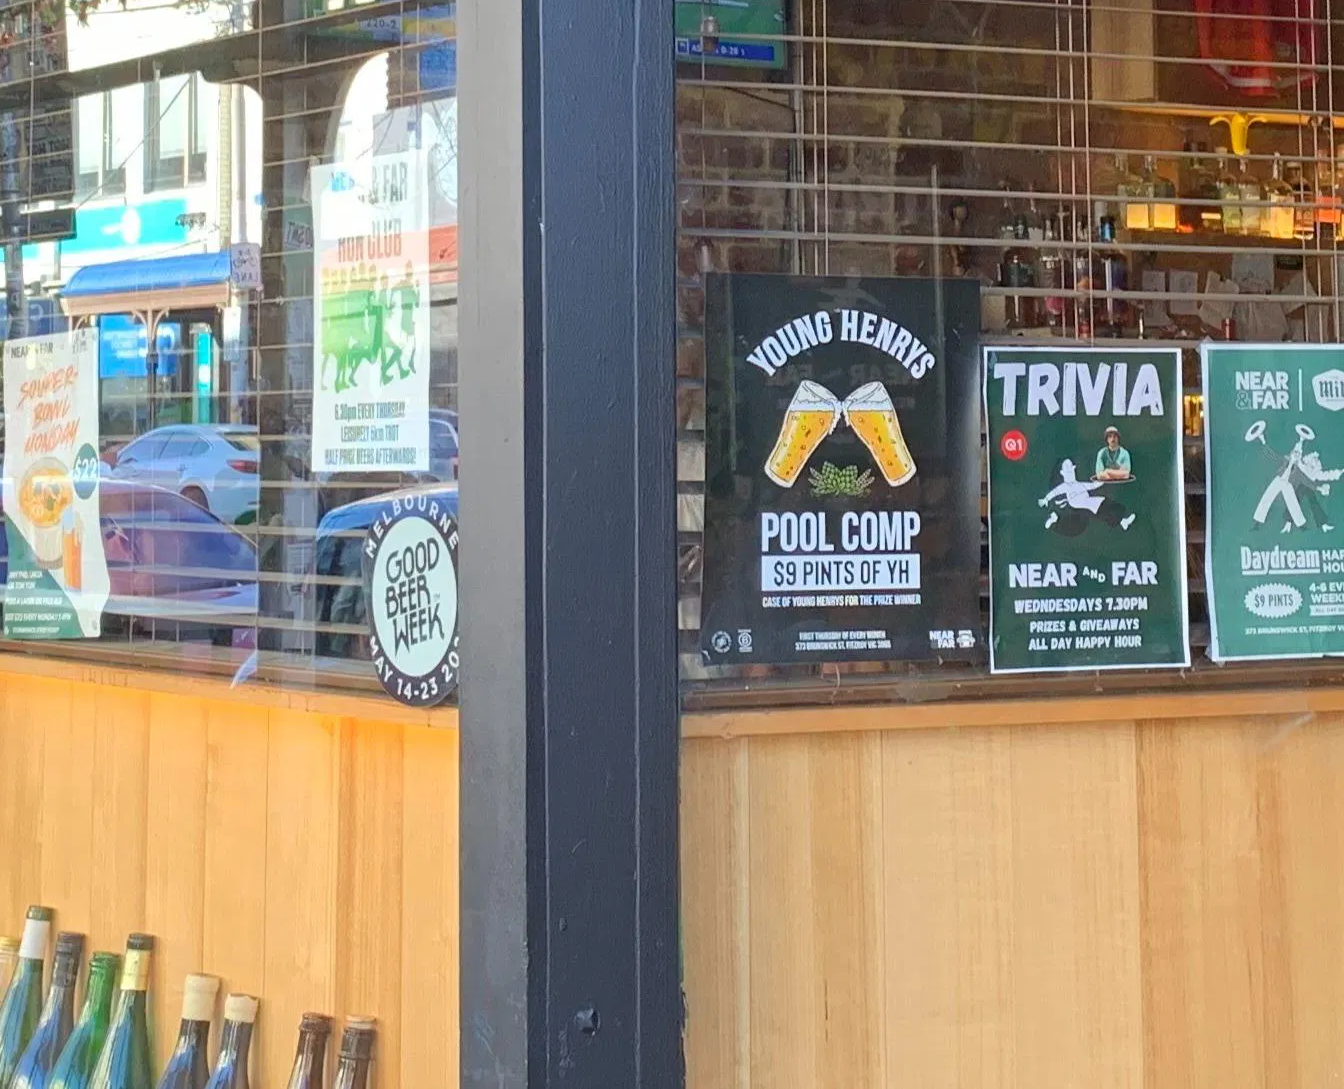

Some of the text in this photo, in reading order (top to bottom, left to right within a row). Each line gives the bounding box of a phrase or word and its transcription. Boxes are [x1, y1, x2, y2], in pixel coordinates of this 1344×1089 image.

[382, 161, 408, 203] FAR
[745, 309, 937, 380] YOUNG HENRYS
[993, 362, 1165, 416] TRIVIA
[1236, 371, 1289, 390] NEAR
[1005, 439, 1024, 451] Q1
[73, 455, 97, 480] $22
[365, 494, 459, 559] MELBOURNE
[761, 510, 921, 553] POOL COMP
[386, 537, 440, 584] GOOD
[774, 560, 910, 587] $9 PINTS OF YH
[1240, 545, 1321, 574] Daydream
[1008, 561, 1158, 588] NEAR AND FAR
[386, 573, 431, 621] BEER
[762, 596, 782, 608] CASE
[793, 596, 816, 607] YOUNG
[817, 595, 844, 607] HENRYS
[845, 595, 859, 606] FOR
[860, 595, 872, 605] THE
[873, 595, 893, 605] PRIZE
[894, 594, 921, 606] WINNER
[1106, 596, 1148, 610] 7.30PM
[1254, 593, 1294, 608] $9 PINTS
[392, 602, 445, 658] WEEK
[1029, 618, 1140, 633] PRIZES & GIVEAWAYS
[1028, 635, 1142, 651] ALL DAY HAPPY HOUR
[397, 675, 439, 700] 14-23
[441, 636, 460, 683] 20
